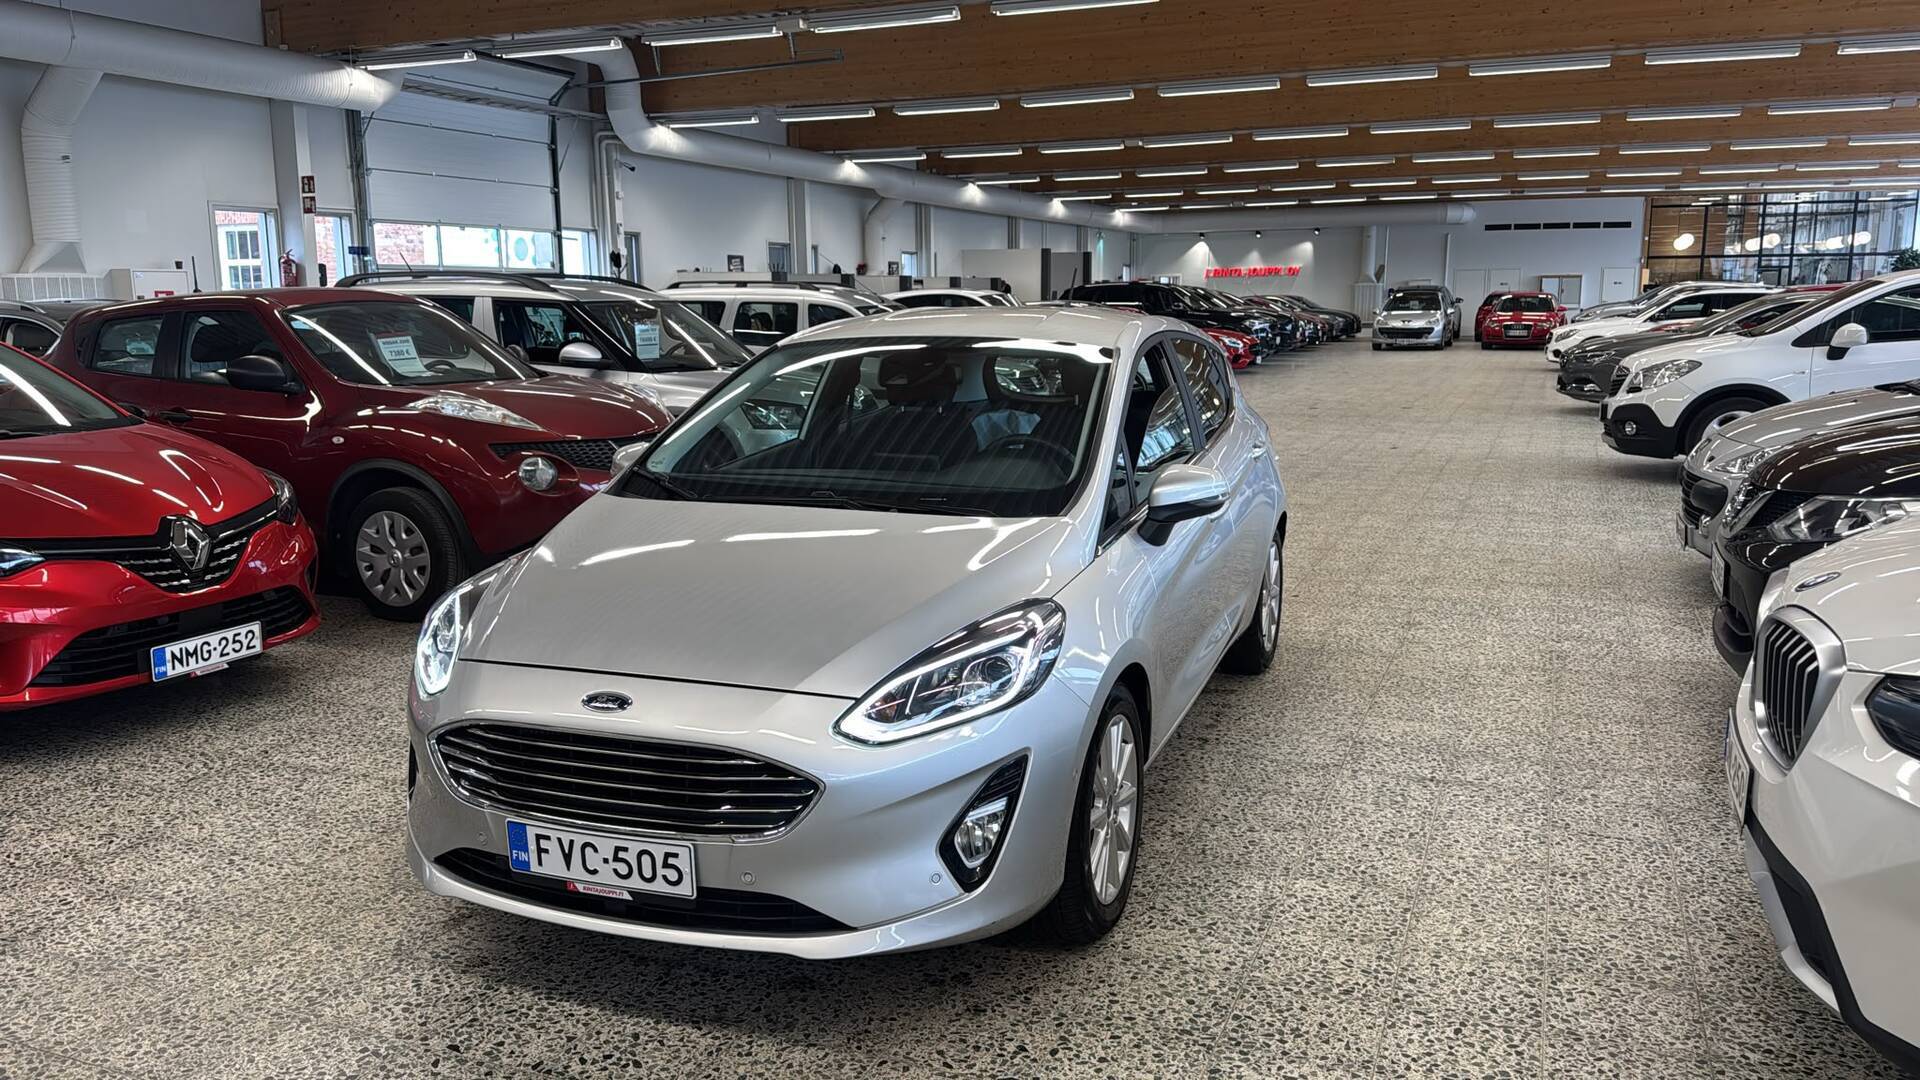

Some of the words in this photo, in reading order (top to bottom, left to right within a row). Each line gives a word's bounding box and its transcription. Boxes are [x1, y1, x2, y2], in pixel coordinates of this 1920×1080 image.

[170, 629, 257, 671] NMG-252
[155, 665, 167, 675] FIN
[512, 849, 529, 862] FIN
[534, 832, 685, 887] FVC-505
